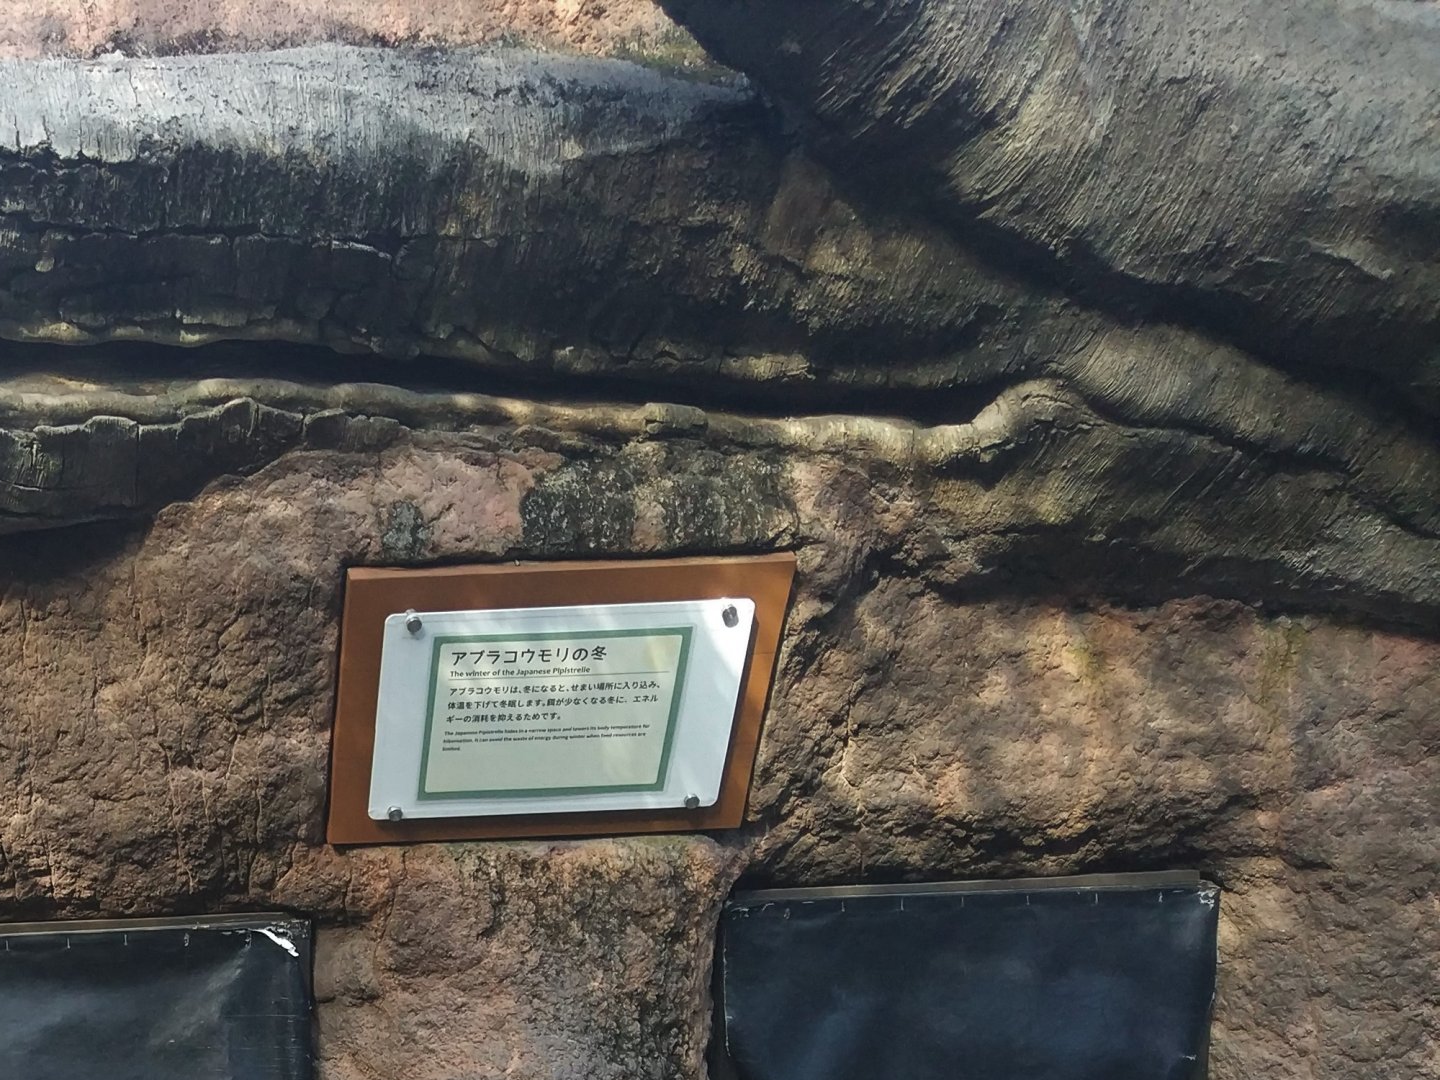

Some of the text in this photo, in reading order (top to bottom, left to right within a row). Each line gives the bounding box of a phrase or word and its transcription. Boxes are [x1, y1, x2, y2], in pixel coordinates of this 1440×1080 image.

[452, 646, 607, 666] アブラコウモリの冬
[450, 670, 464, 678] The
[466, 669, 490, 677] winter
[502, 668, 514, 676] the
[516, 668, 551, 677] Japanese
[552, 666, 591, 675] Pipistrelle
